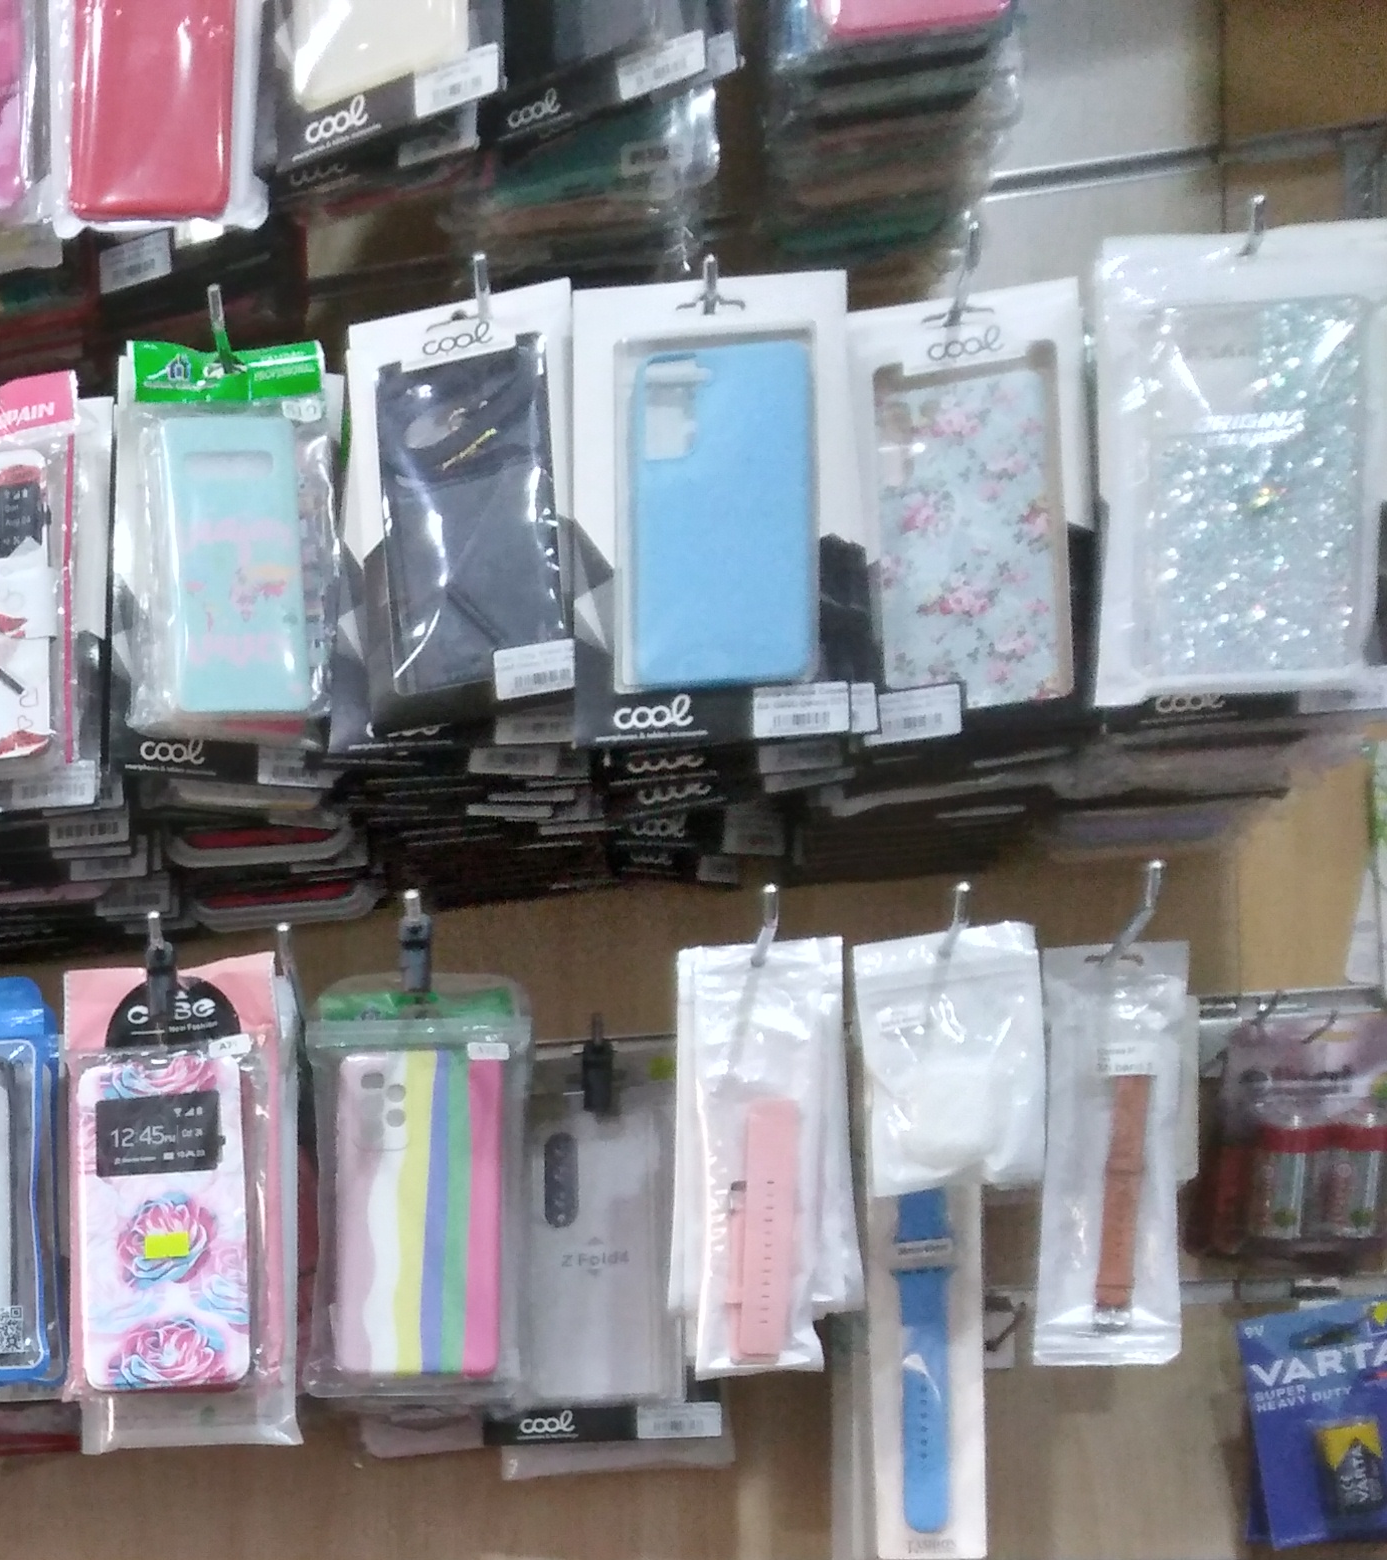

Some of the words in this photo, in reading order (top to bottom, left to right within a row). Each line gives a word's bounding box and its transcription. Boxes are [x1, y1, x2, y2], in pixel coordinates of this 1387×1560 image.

[305, 94, 369, 144] cool
[613, 693, 693, 730] cool
[1243, 1324, 1264, 1339] 9V
[1254, 1384, 1307, 1403] SUPER
[1311, 1385, 1353, 1402] DUTY
[519, 1409, 575, 1435] cool
